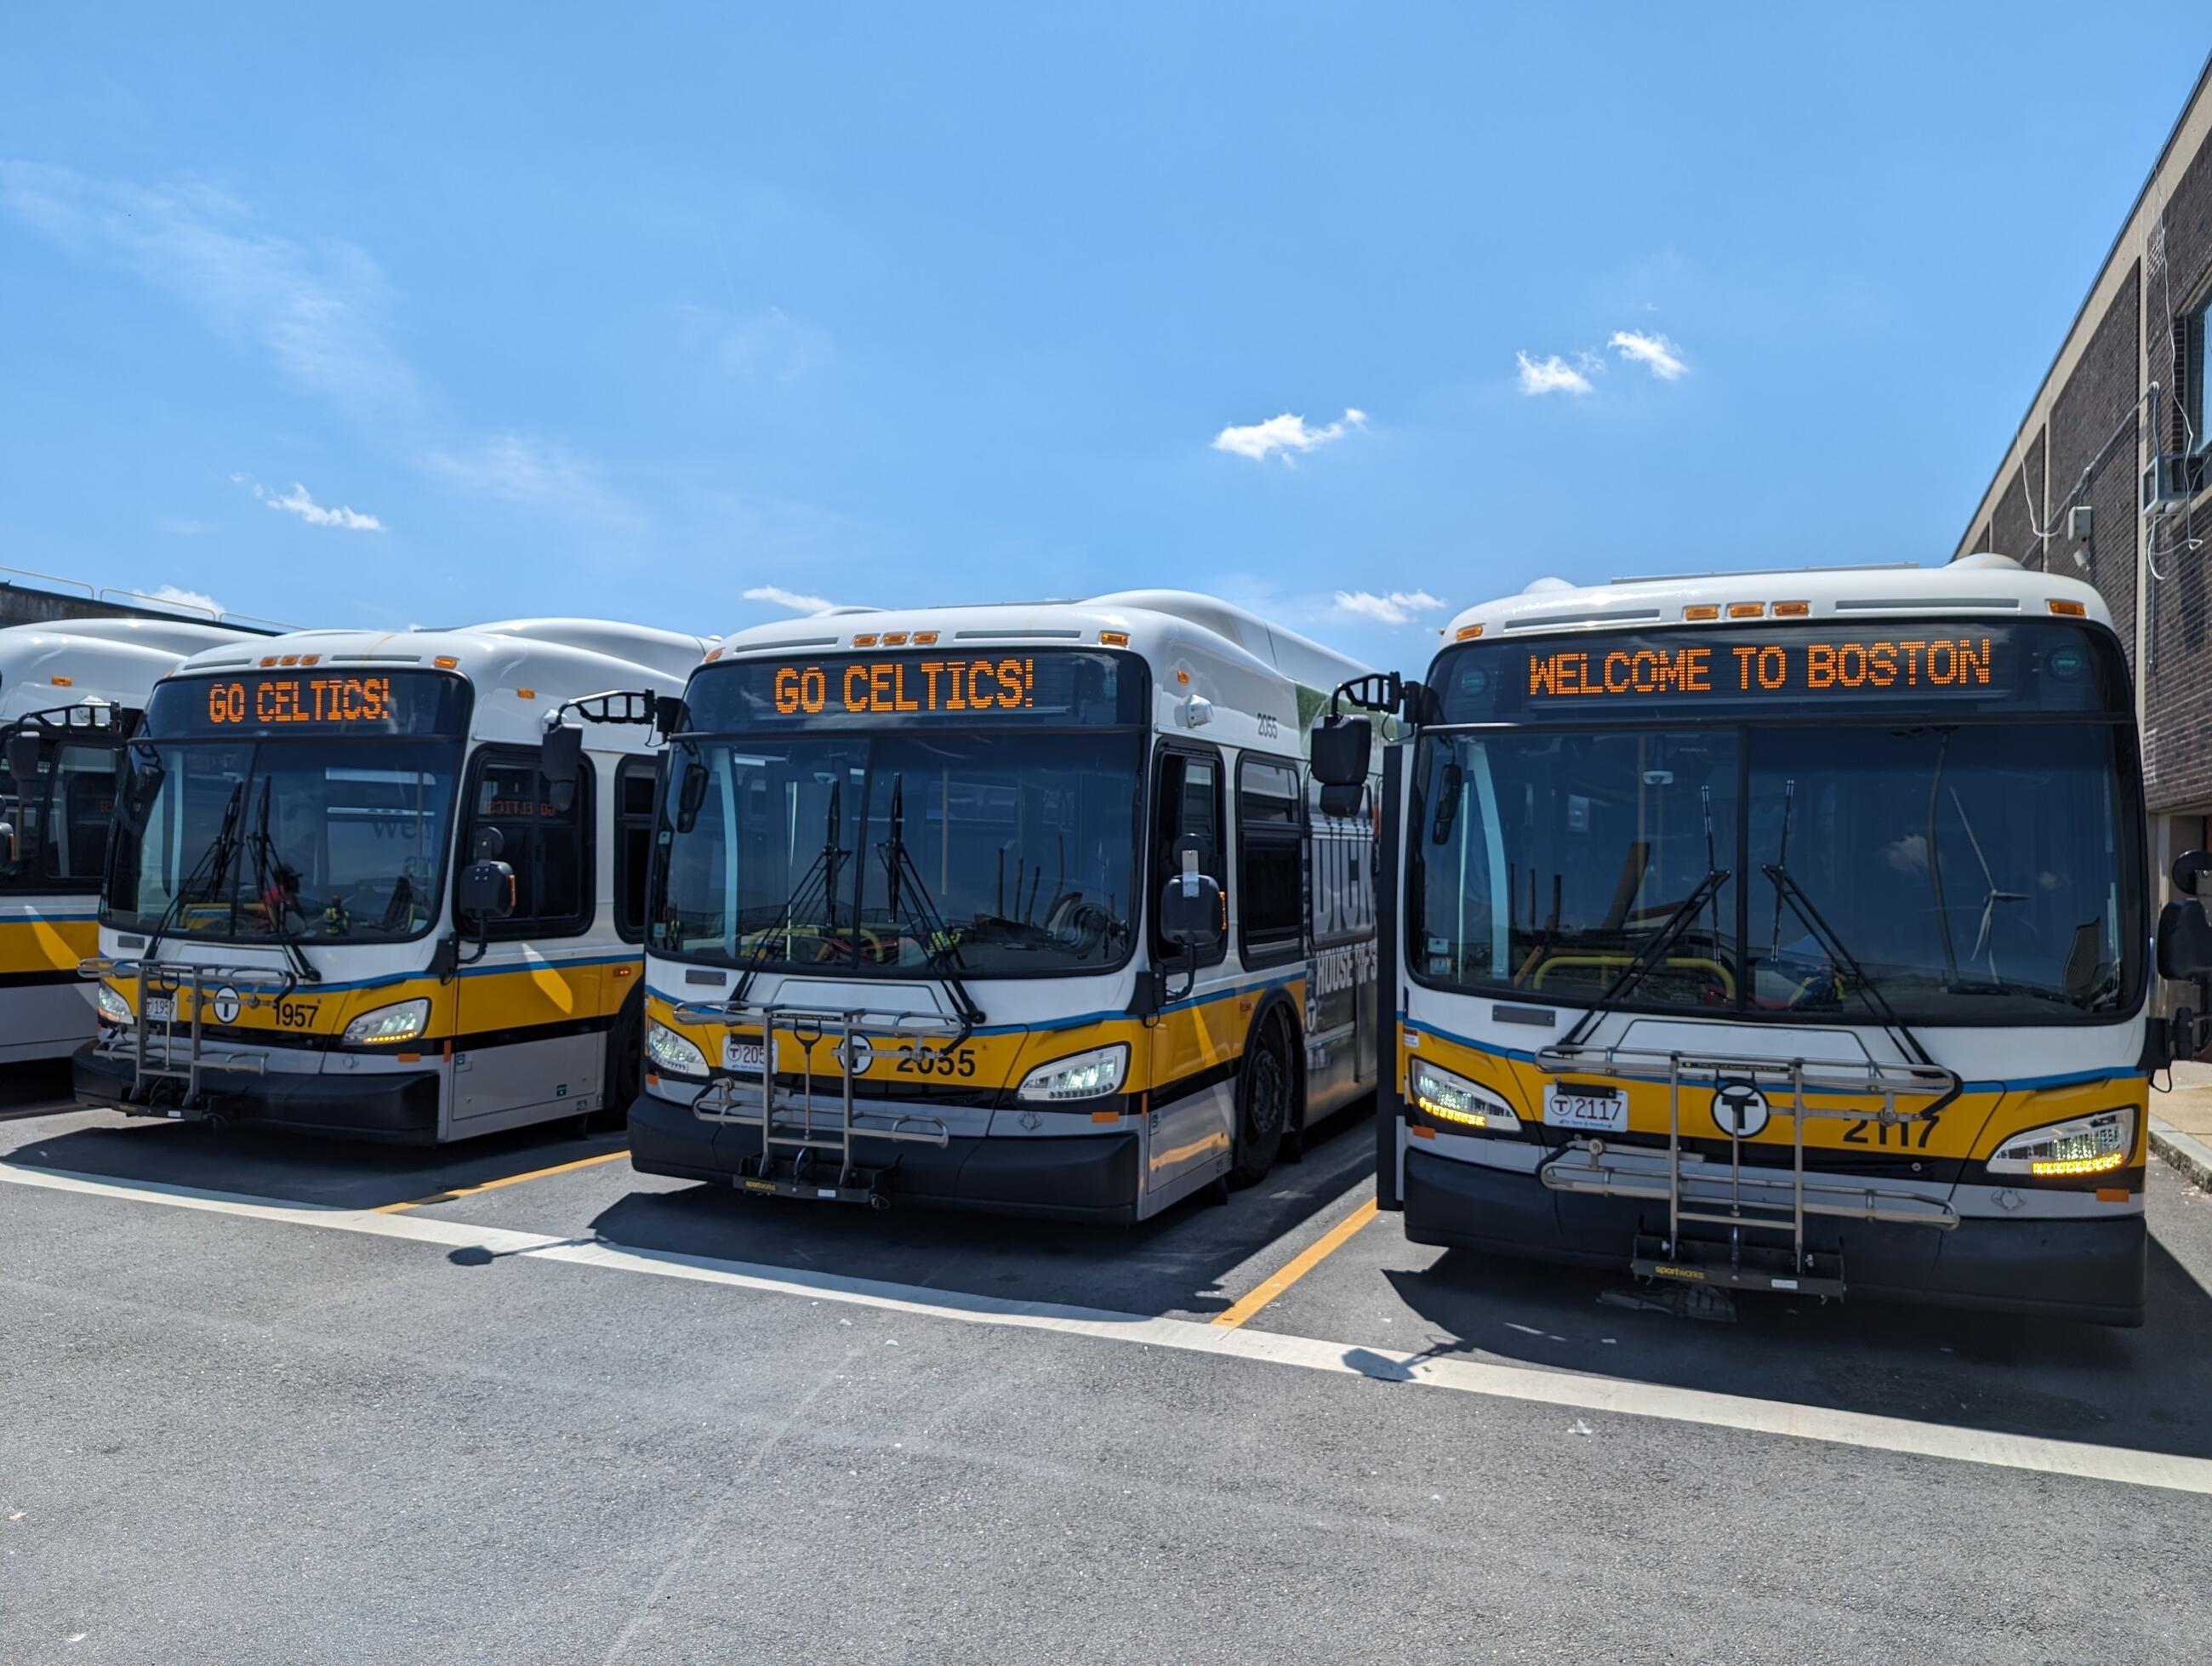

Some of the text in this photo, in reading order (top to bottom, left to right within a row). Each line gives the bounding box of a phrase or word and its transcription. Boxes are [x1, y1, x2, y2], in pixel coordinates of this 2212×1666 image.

[1530, 639, 1991, 694] WELCOME TO BOSTON
[209, 678, 389, 722] GO CELTICS!
[774, 659, 1034, 714] GO CELTICS!
[1257, 712, 1278, 739] 2055
[1316, 945, 1353, 996] HOUSE
[275, 1001, 319, 1028] 1957
[896, 1045, 976, 1077] 2055
[1575, 1098, 1622, 1121] 2117
[1843, 1109, 1940, 1148] 2117
